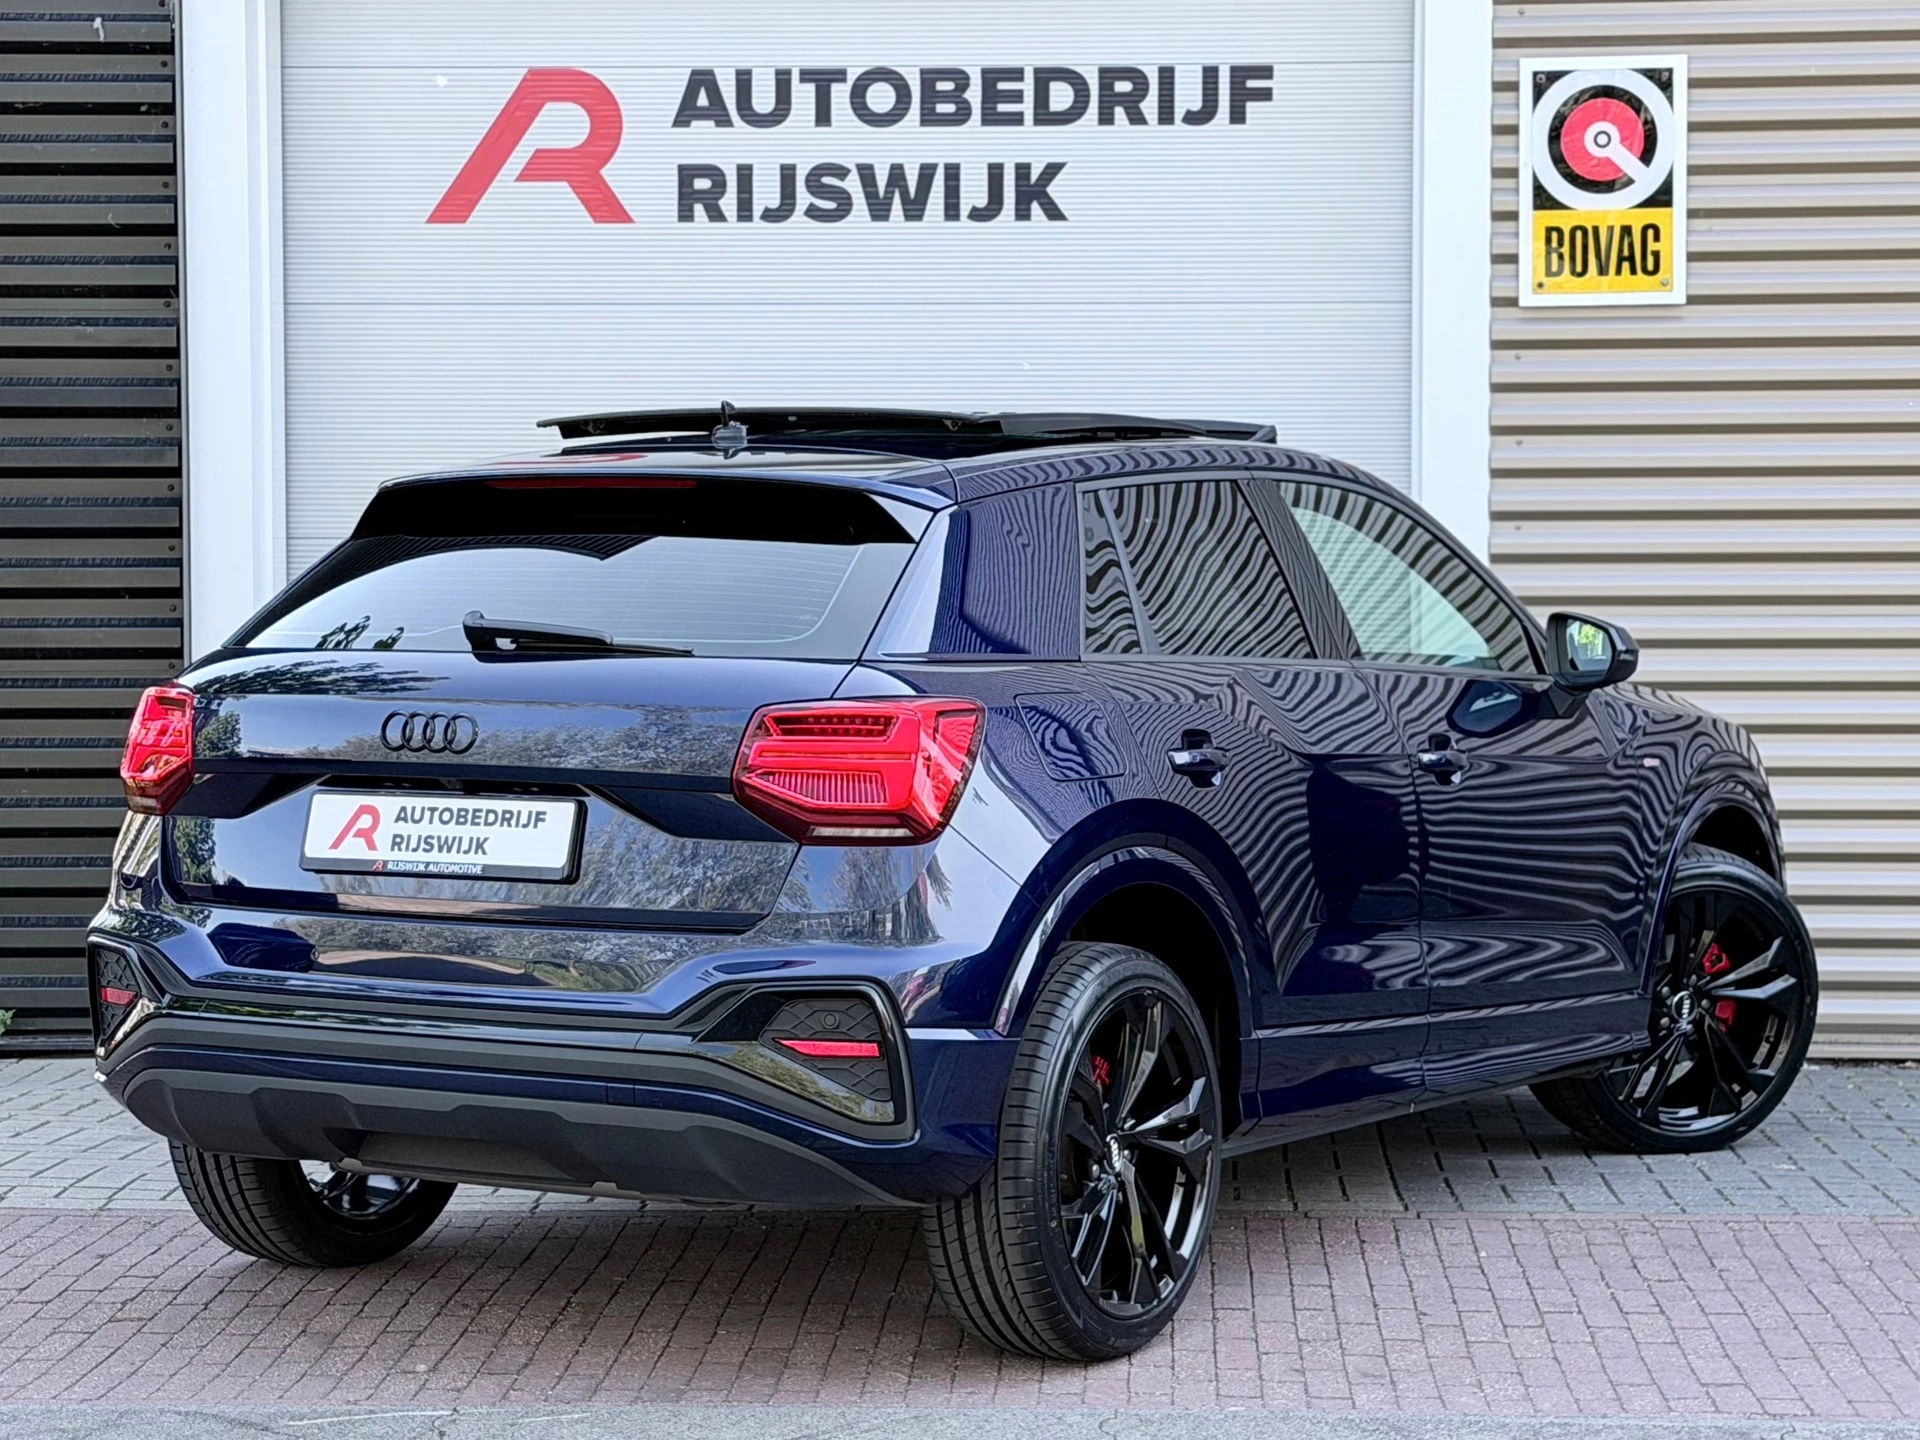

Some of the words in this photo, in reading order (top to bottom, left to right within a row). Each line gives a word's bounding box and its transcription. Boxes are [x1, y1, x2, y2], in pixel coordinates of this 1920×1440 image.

[672, 65, 1274, 129] AUTOBEDRIJF
[677, 162, 1068, 223] RIJSWIJK
[1544, 223, 1661, 278] BOVAG
[393, 805, 547, 830] AUTOBEDRIJF
[390, 833, 490, 856] RIJSWIJK
[387, 861, 426, 872] RIJSWIJK
[427, 862, 483, 875] AUTOMOTIVE
